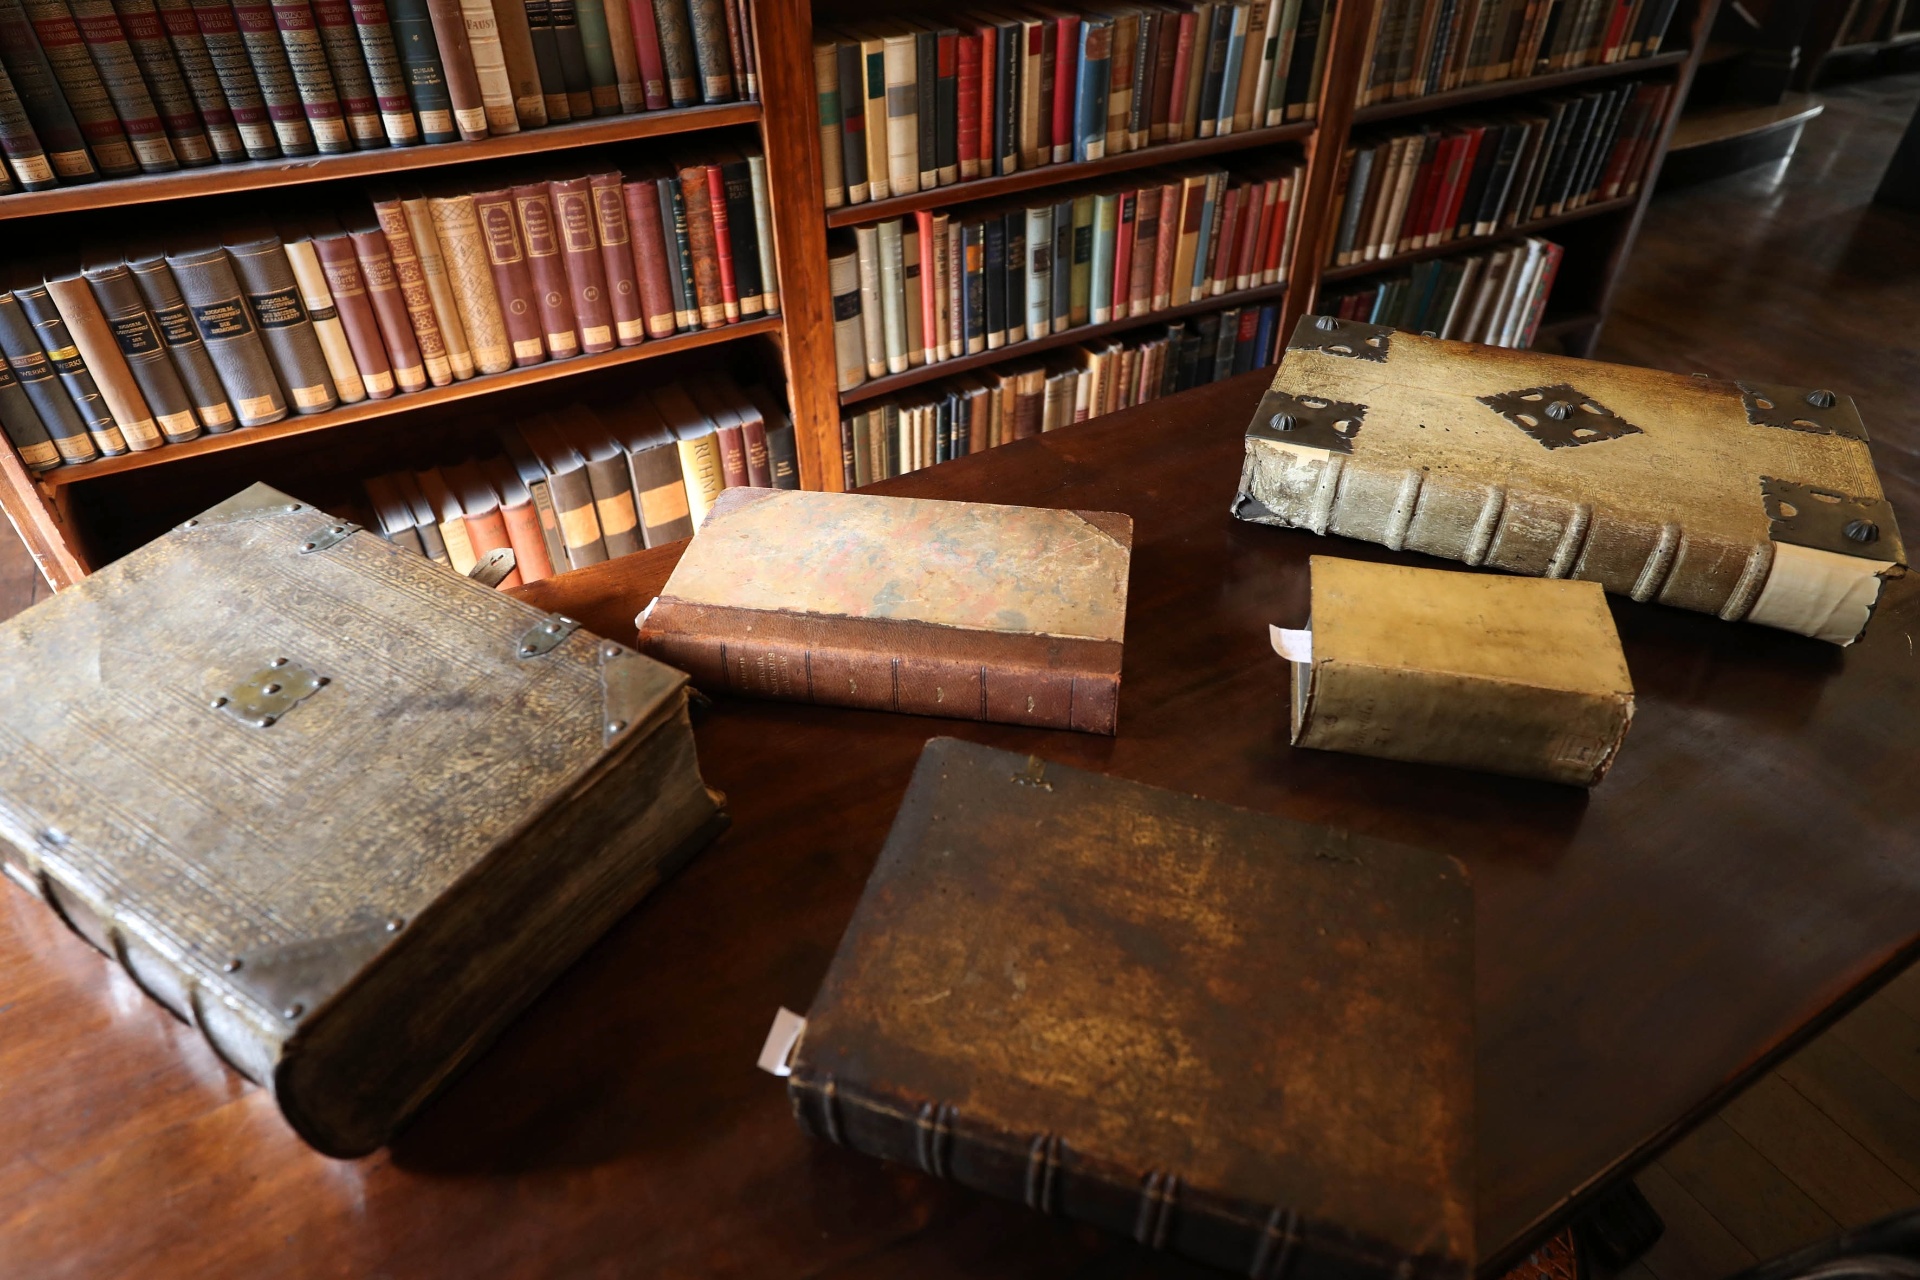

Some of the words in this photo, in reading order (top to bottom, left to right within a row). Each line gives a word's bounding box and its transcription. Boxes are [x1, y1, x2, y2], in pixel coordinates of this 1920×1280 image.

[163, 12, 195, 23] CHILLERS
[325, 14, 343, 22] WERKE
[362, 12, 380, 20] WERKE
[128, 17, 157, 27] CHILLERS
[204, 20, 231, 28] WERKE
[247, 20, 270, 28] WERKE
[285, 19, 307, 27] WERKE
[466, 19, 496, 30] FAUST
[168, 22, 193, 31] WERKE
[132, 123, 148, 131] BAND
[56, 359, 82, 369] WERKE
[19, 367, 46, 376] WERKE
